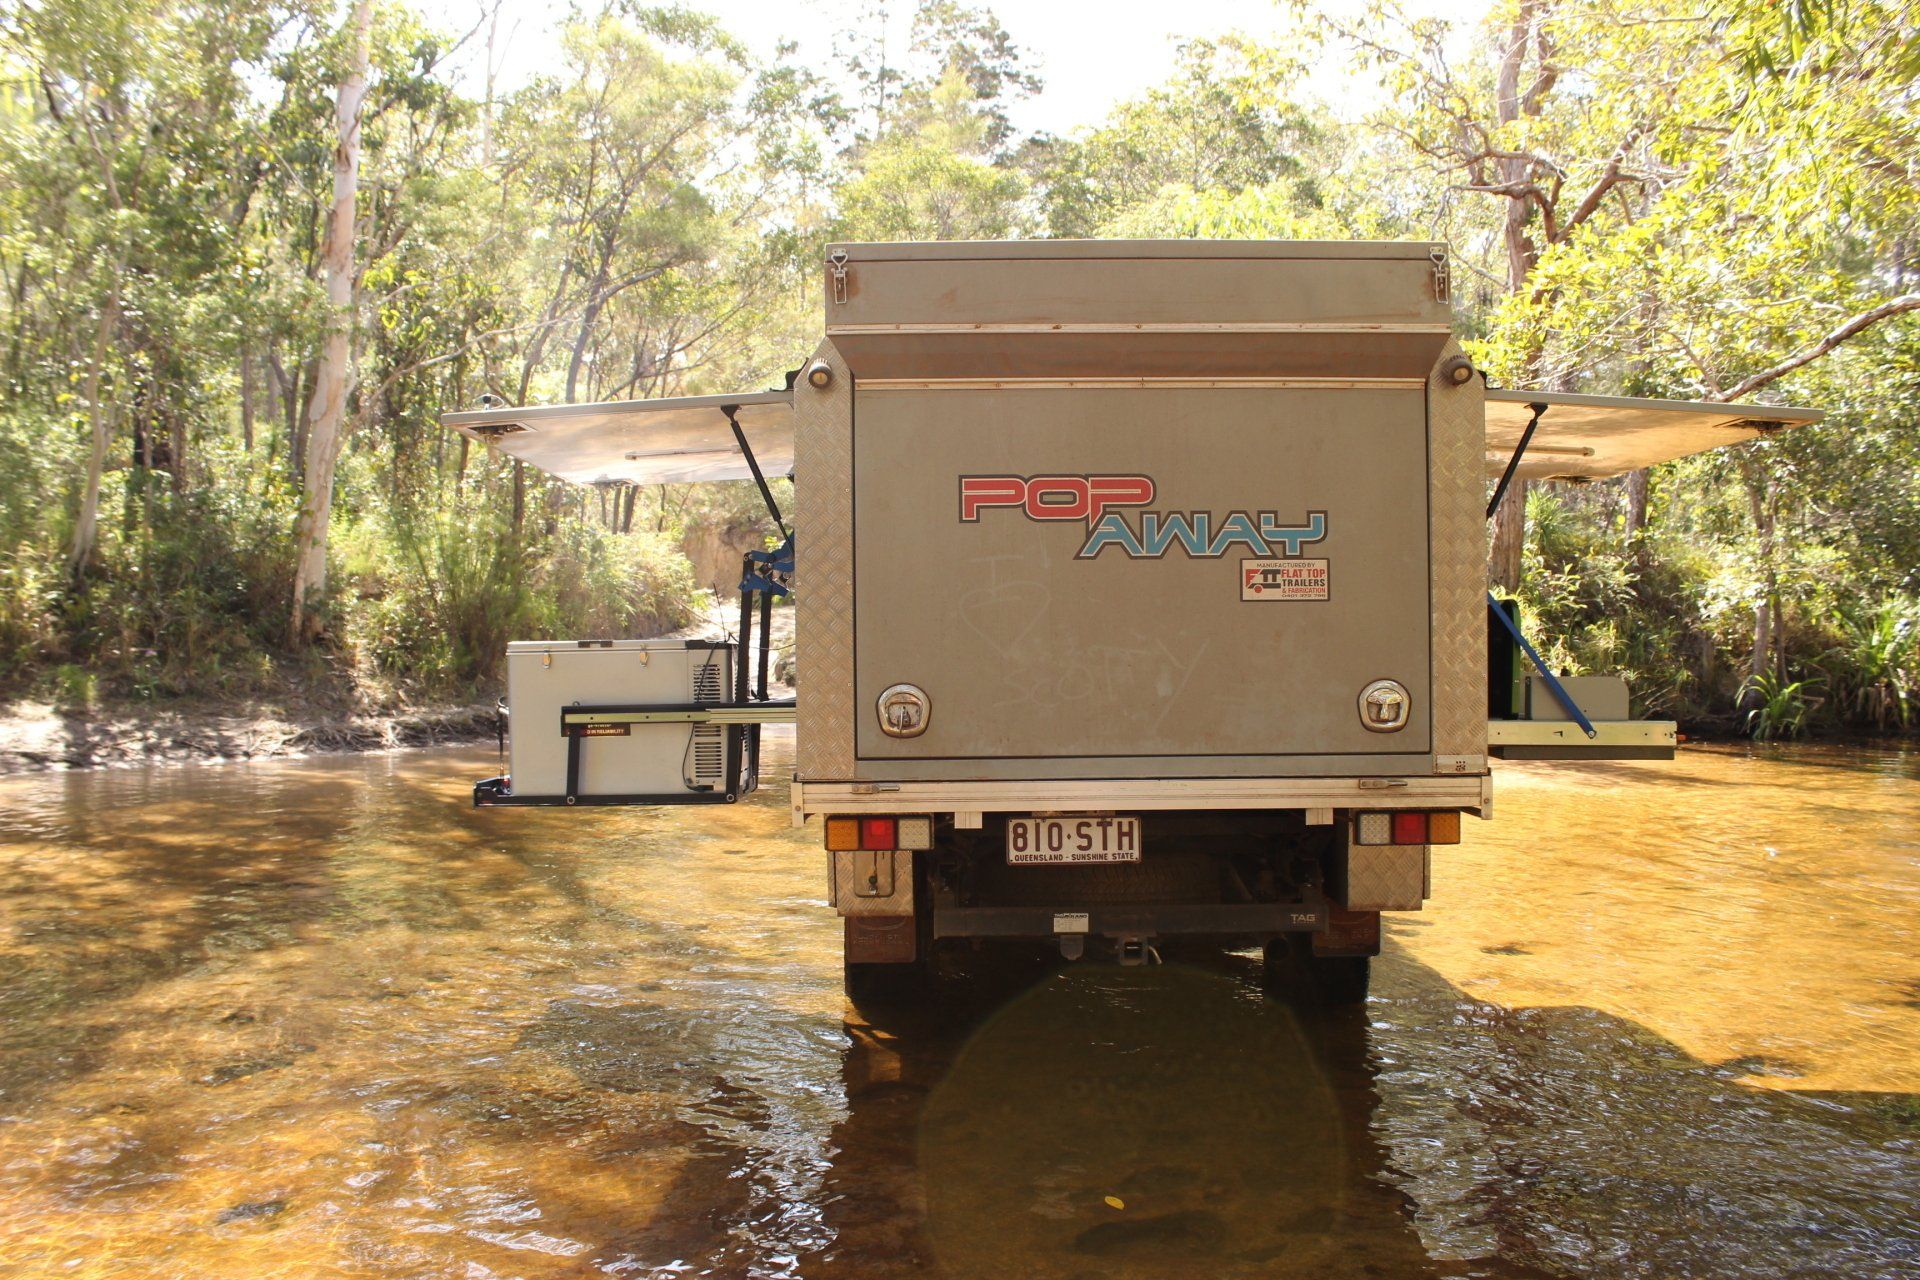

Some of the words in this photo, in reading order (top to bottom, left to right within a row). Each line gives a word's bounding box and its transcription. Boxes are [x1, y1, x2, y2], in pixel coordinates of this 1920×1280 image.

[959, 474, 1156, 531] POP
[1074, 510, 1328, 560] AWAY
[1281, 568, 1303, 578] FLAT
[1306, 568, 1326, 578] TOP
[1281, 578, 1326, 587] TRAILERS
[1014, 853, 1064, 862] QUEENSLAND
[1071, 853, 1108, 861] SUNSHINE
[1111, 852, 1134, 860] STATE
[1290, 913, 1316, 922] TAG
